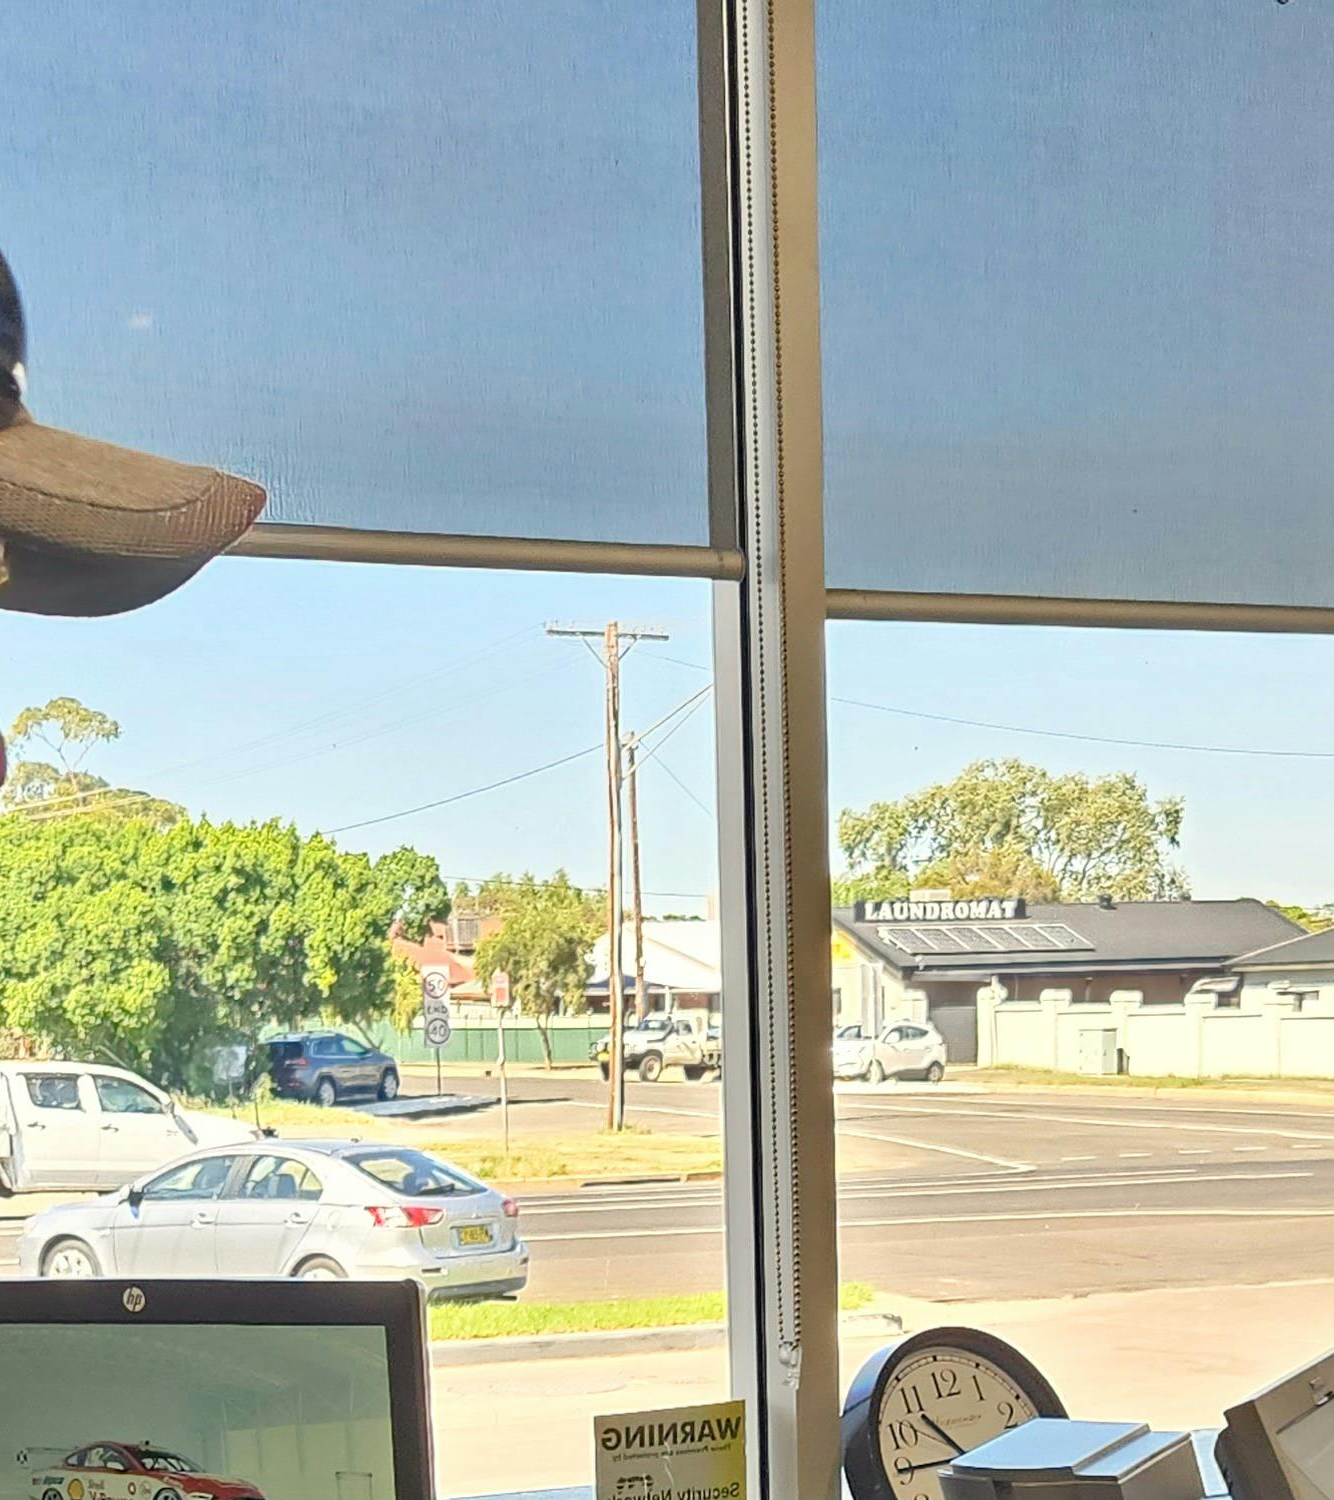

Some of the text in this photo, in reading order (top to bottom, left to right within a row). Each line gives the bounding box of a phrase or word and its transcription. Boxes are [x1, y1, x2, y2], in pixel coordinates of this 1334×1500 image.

[864, 900, 1017, 921] LAUNDROMAT
[430, 1025, 447, 1037] 40
[126, 1287, 142, 1312] hp
[931, 1368, 962, 1399] 12
[972, 1375, 986, 1402] 1
[899, 1385, 925, 1415] 11
[997, 1401, 1019, 1430] 2
[888, 1420, 918, 1450] 10
[894, 1456, 915, 1486] 9
